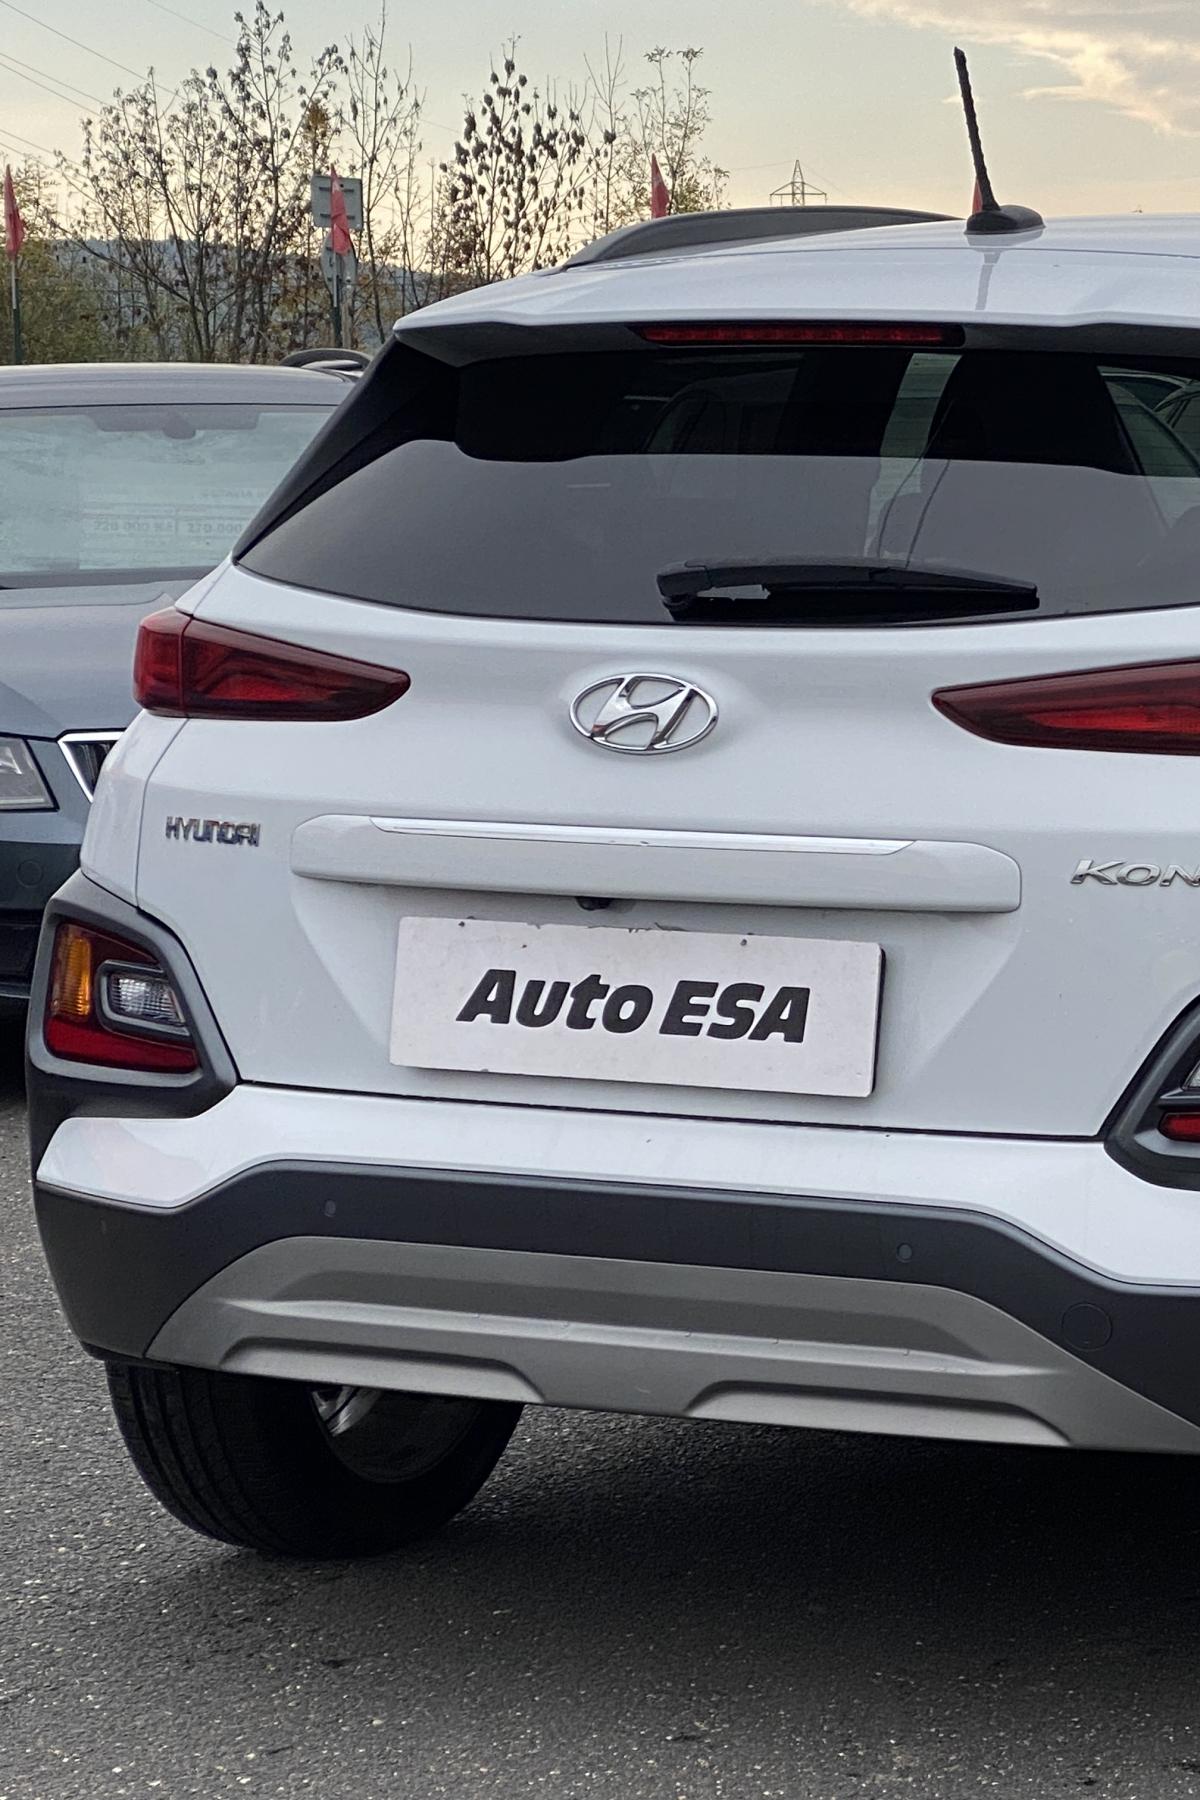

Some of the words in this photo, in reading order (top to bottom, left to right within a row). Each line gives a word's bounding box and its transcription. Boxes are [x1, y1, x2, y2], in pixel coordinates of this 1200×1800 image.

[165, 816, 261, 848] HYUNDAI
[455, 968, 654, 1035] Auto
[658, 979, 811, 1044] ESA
